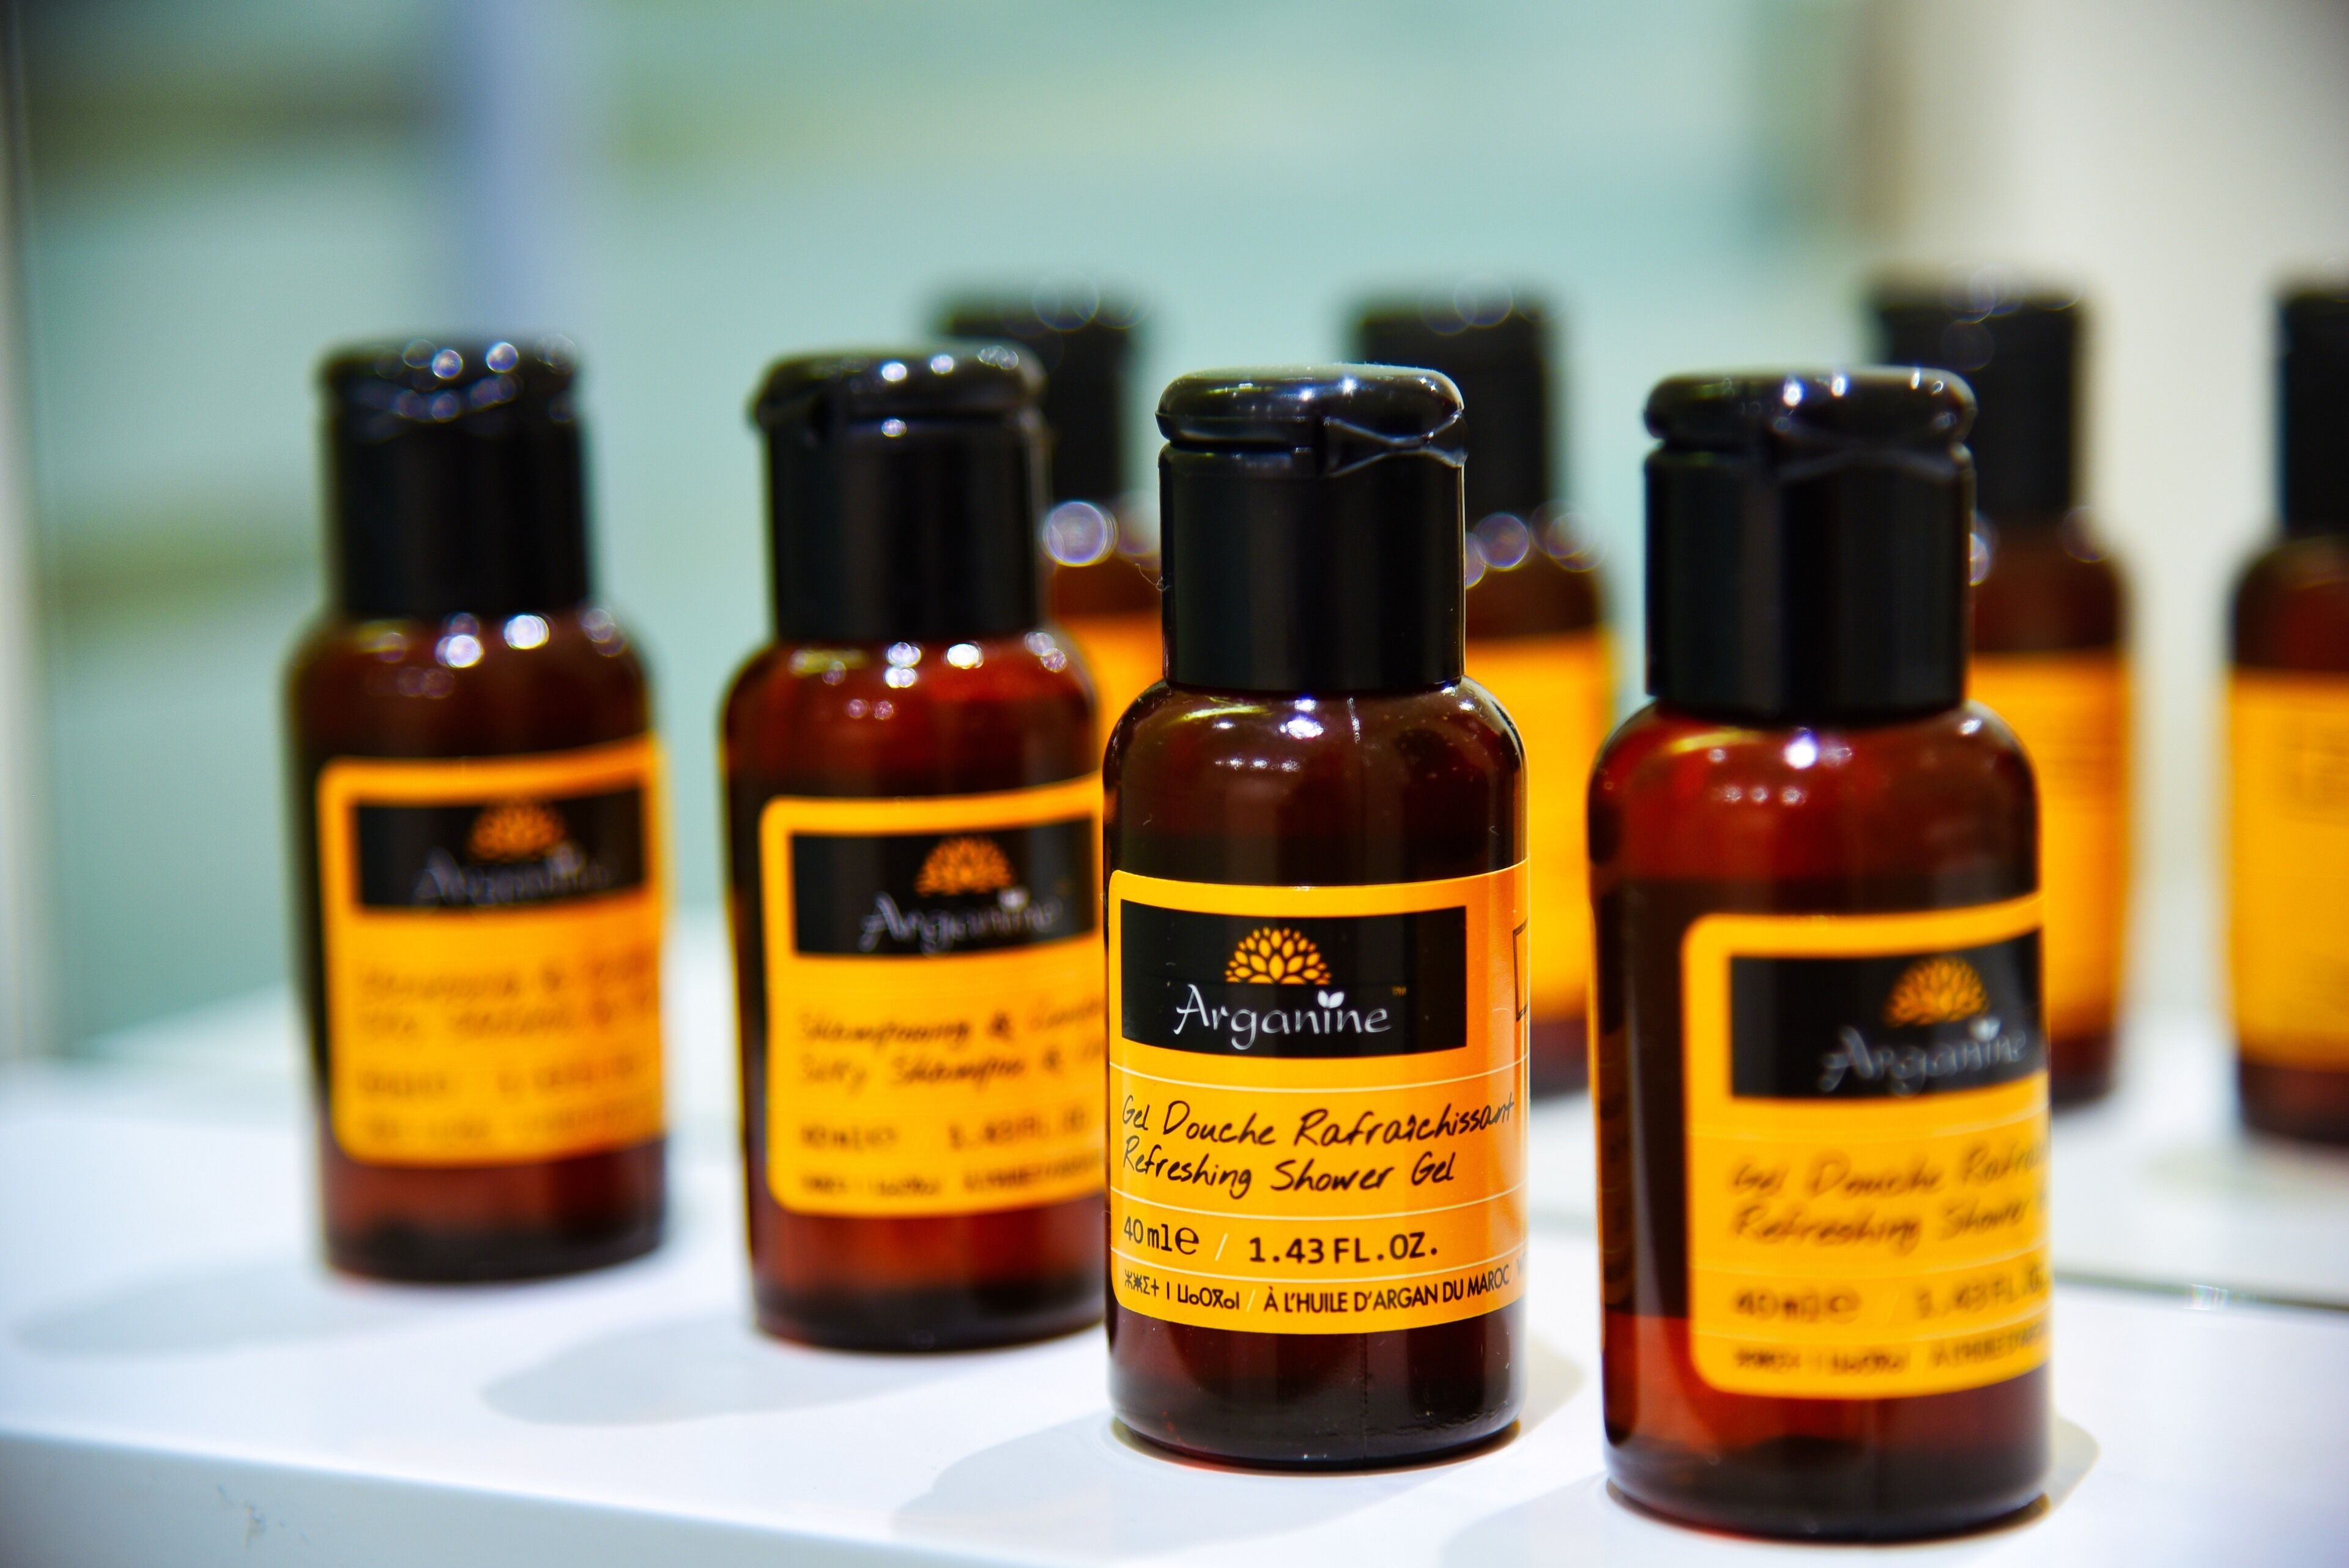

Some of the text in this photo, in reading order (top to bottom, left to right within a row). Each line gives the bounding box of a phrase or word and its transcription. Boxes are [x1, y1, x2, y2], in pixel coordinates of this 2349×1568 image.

[1173, 983, 1392, 1050] Arganine
[1123, 1094, 1150, 1131] Gel
[1163, 1100, 1276, 1145] Douche
[1123, 1135, 1252, 1200] Refreshing
[1270, 1158, 1395, 1191] Shower
[1411, 1151, 1457, 1186] Gel
[1249, 1237, 1324, 1265] 1.43
[1264, 1285, 1278, 1313] À
[1442, 1278, 1464, 1303] DU
[1467, 1263, 1510, 1298] MAROC
